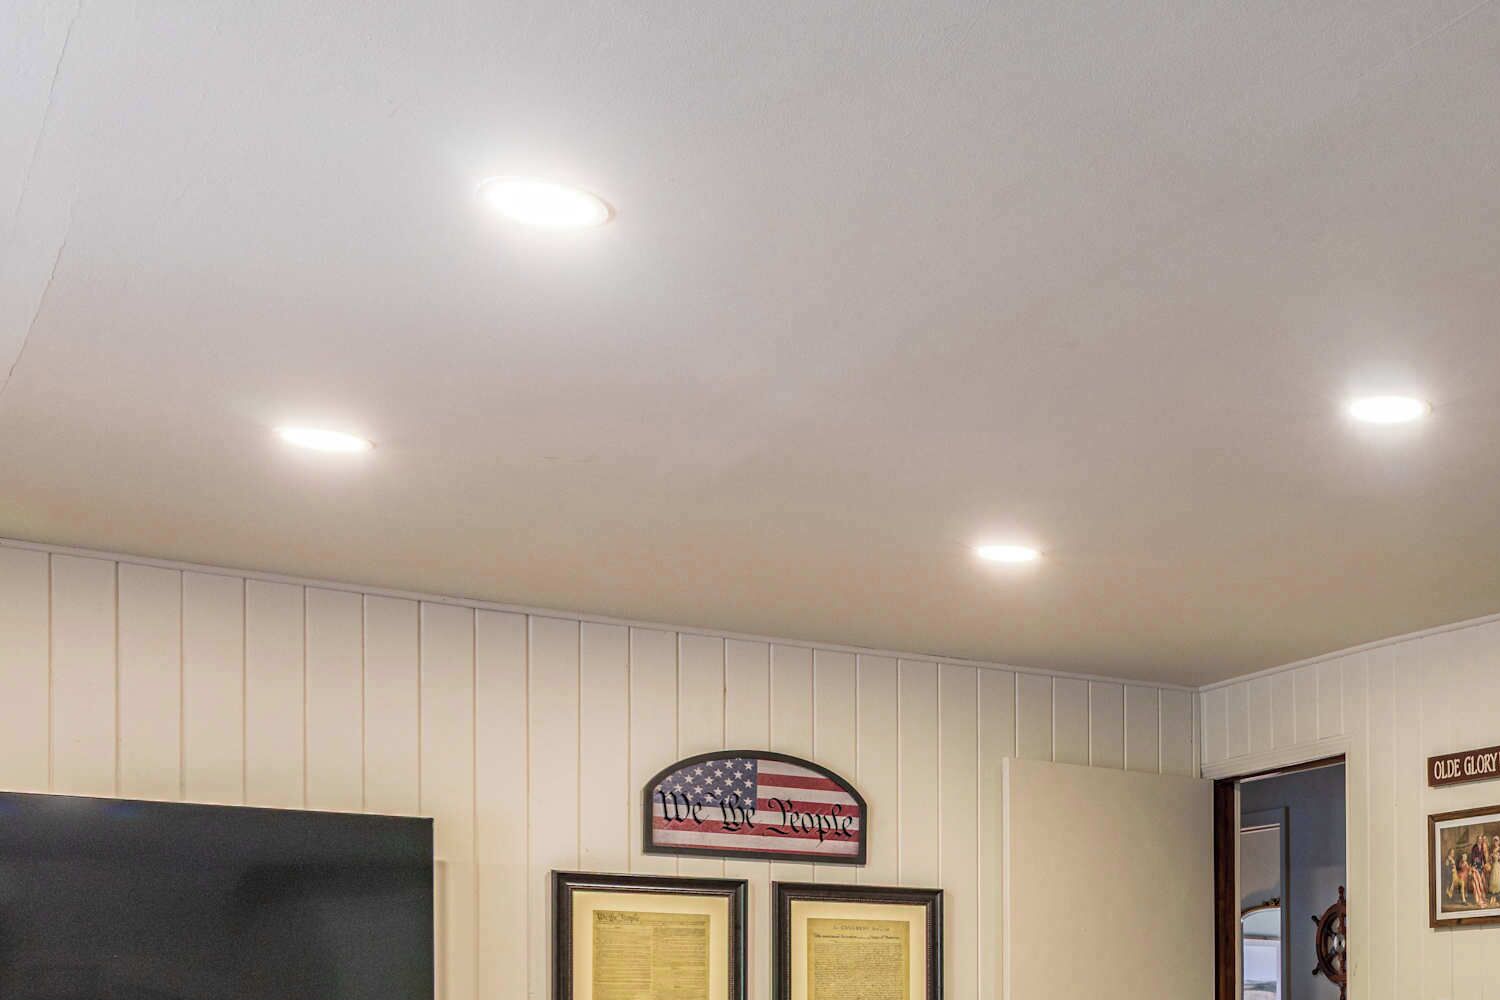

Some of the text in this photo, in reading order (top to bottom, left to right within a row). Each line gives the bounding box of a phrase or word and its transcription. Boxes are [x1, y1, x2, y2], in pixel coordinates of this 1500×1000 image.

[1433, 751, 1499, 780] OLDE GLORY
[656, 789, 854, 849] We the People
